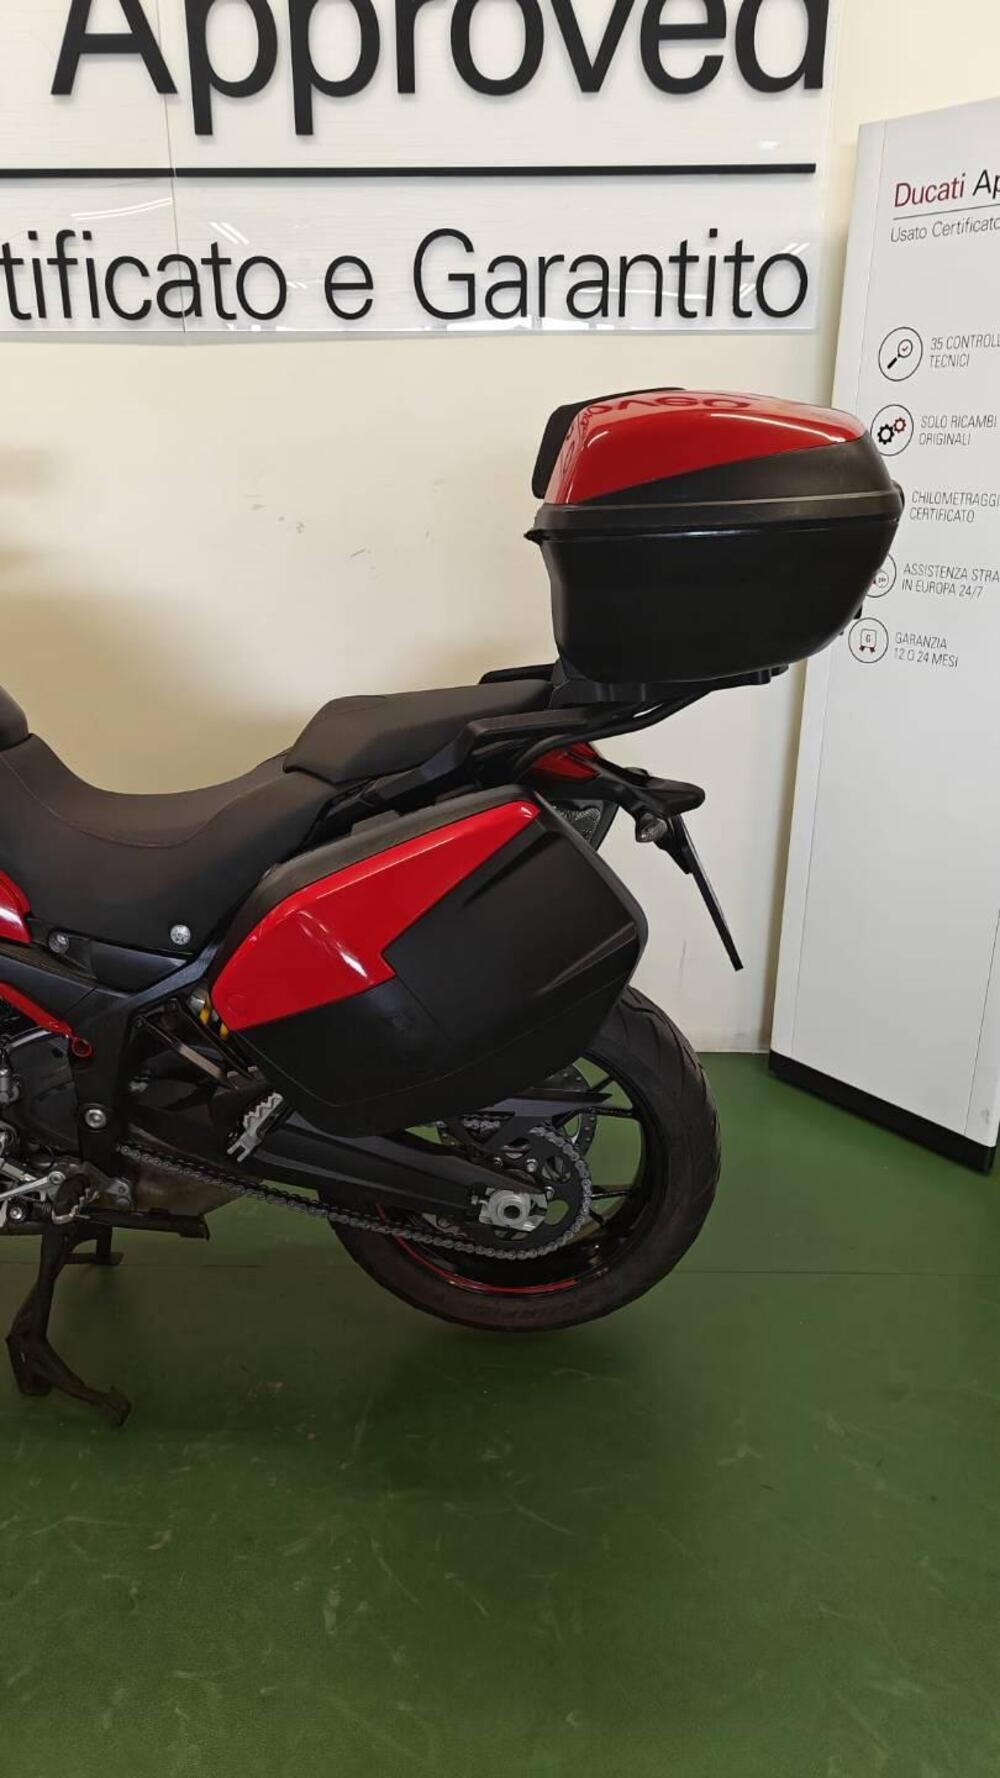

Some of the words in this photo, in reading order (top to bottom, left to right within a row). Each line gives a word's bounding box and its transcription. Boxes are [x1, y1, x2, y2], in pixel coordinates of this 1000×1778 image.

[51, 0, 829, 136] Approved
[894, 172, 966, 207] Ducati
[890, 226, 928, 243] Usato
[0, 229, 288, 321] tificato
[324, 255, 374, 320] e
[413, 228, 808, 320] Garantito
[930, 336, 943, 351] 35
[929, 353, 970, 368] TECNICI
[920, 415, 948, 429] SOLO
[950, 414, 997, 429] RICAMBI
[919, 432, 971, 446] ORIGINALI
[909, 506, 975, 523] CERTIFICATO
[903, 563, 968, 580] ASSISTENZA
[901, 579, 913, 592] IN
[915, 580, 956, 595] EUROPA
[959, 584, 984, 600] 24/7
[895, 631, 948, 649] GARANZIA
[895, 647, 905, 660] 12
[916, 651, 930, 663] 24
[931, 653, 959, 668] MESI
